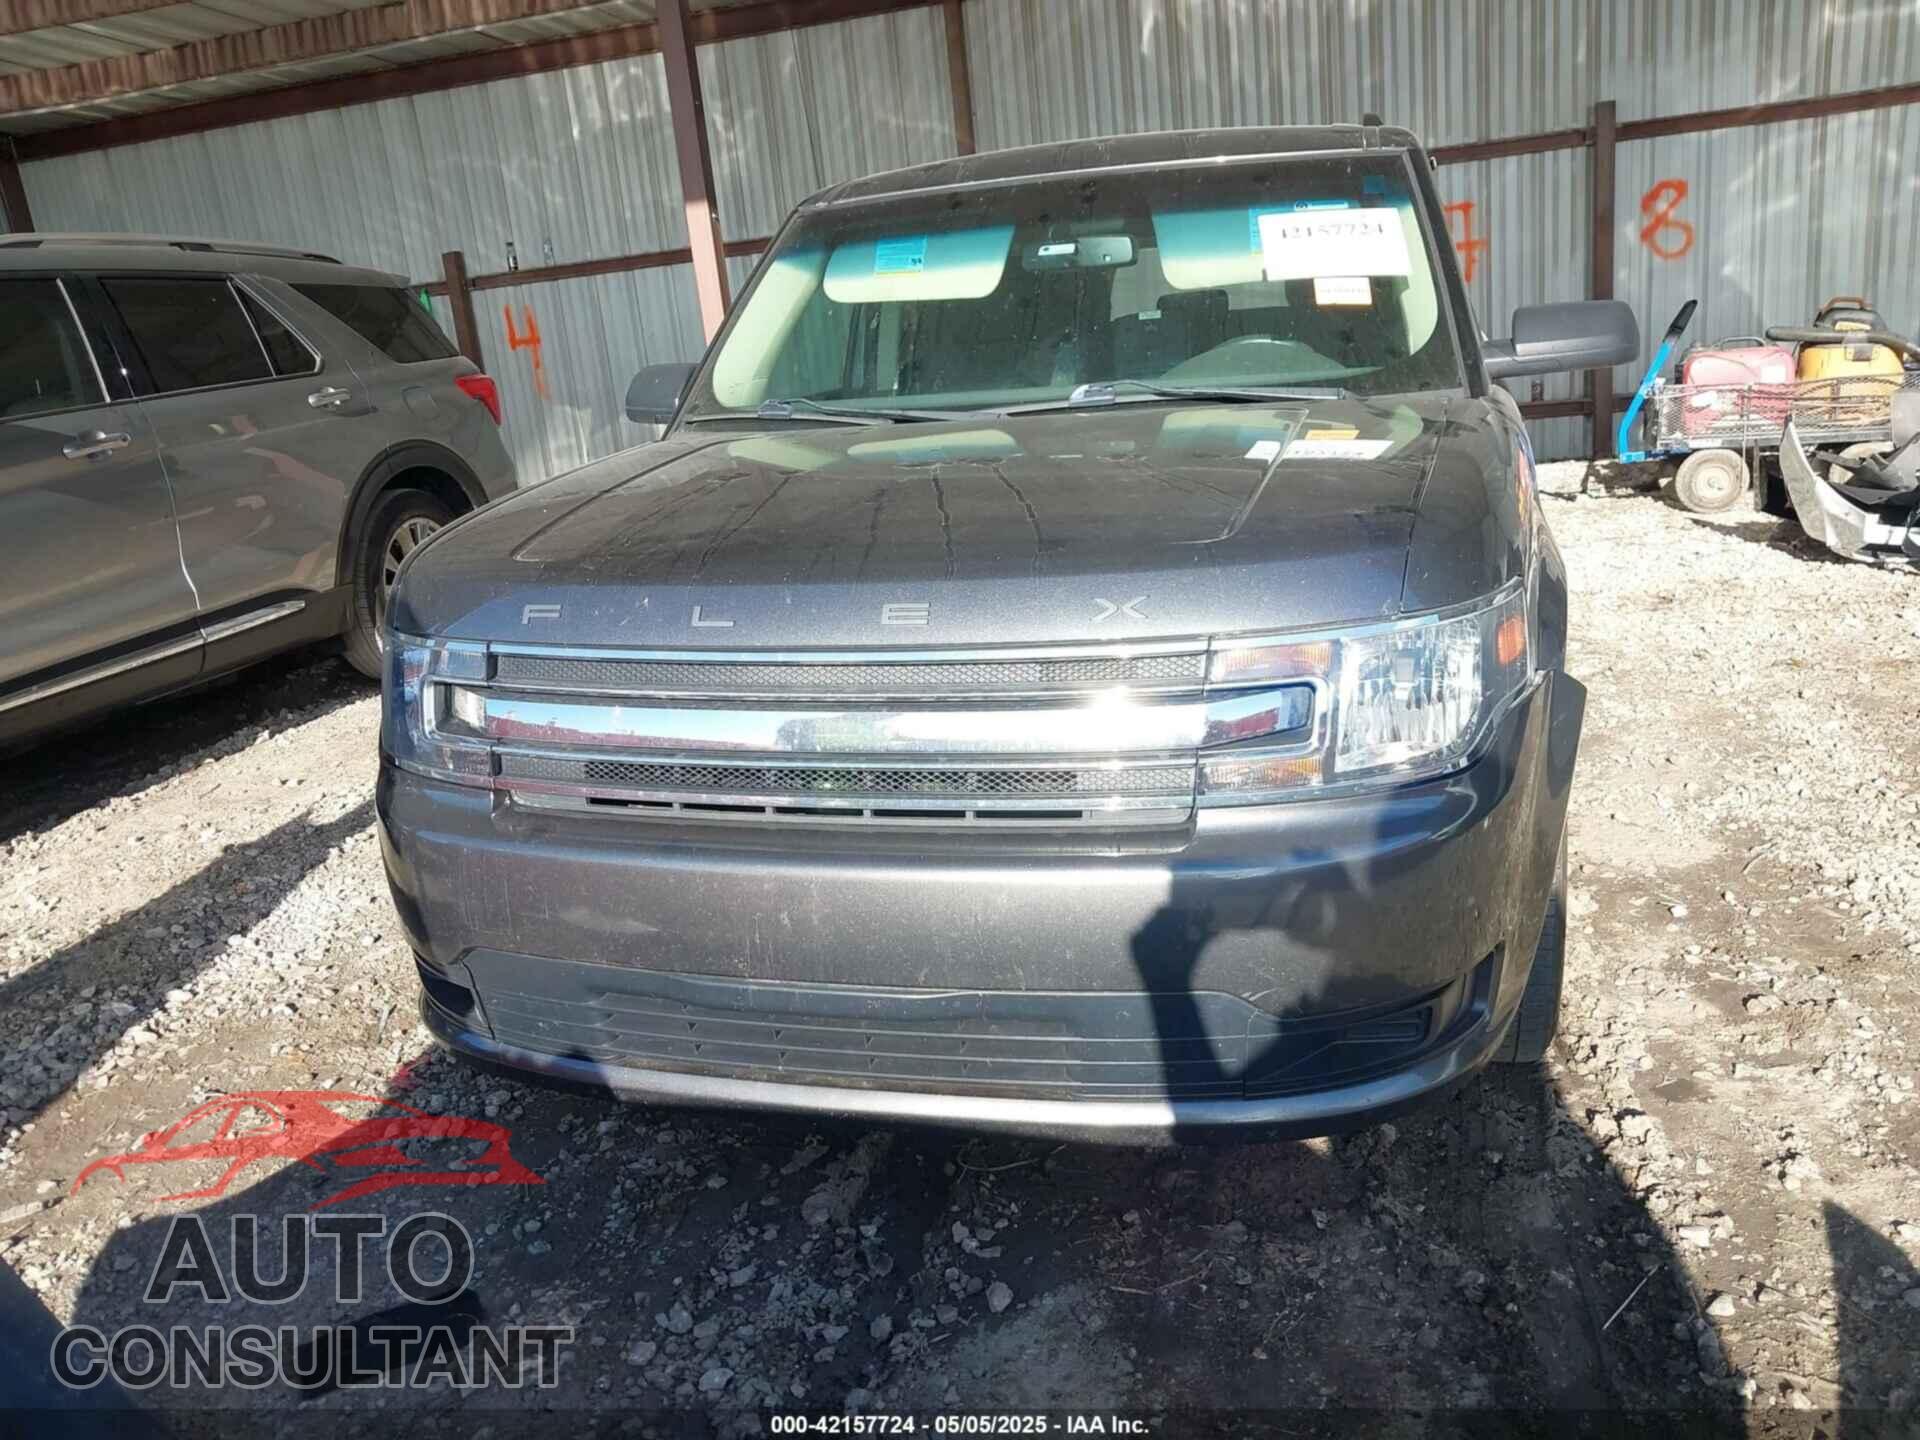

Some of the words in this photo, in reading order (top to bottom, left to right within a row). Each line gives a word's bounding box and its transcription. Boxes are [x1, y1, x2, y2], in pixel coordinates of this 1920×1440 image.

[1639, 178, 1696, 260] 8
[503, 303, 548, 398] 4
[520, 594, 1152, 628] FLEX
